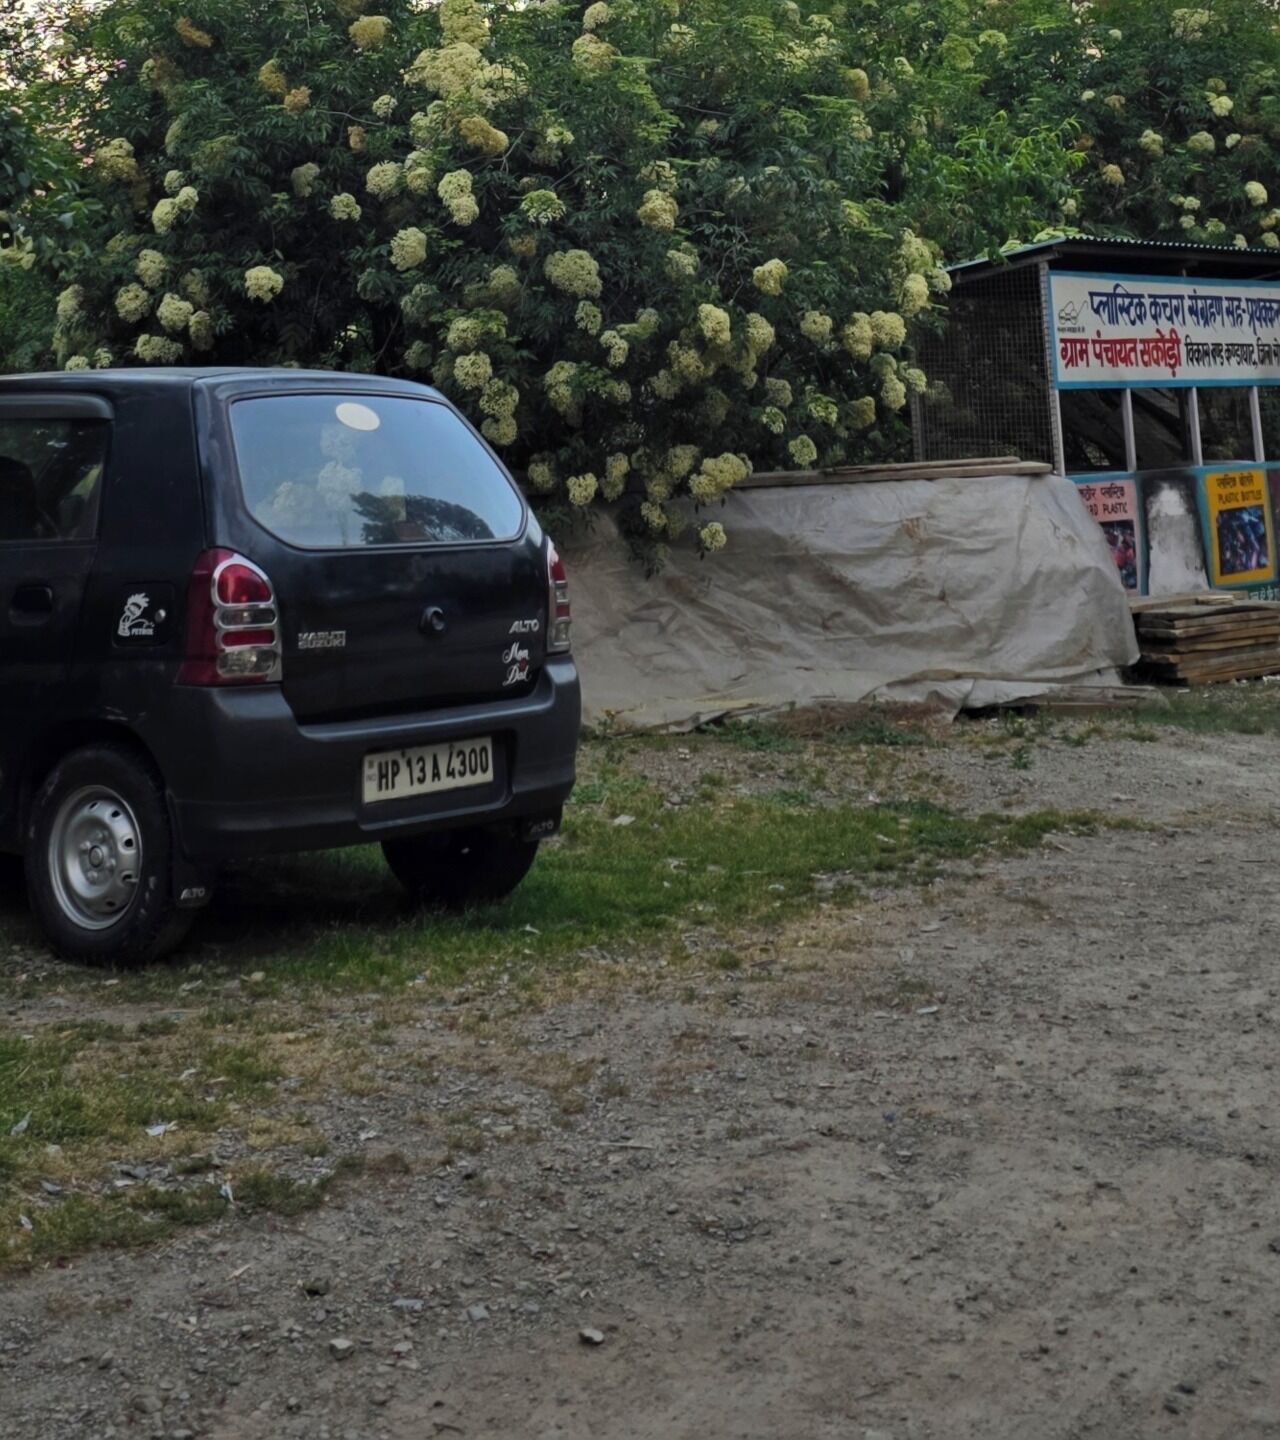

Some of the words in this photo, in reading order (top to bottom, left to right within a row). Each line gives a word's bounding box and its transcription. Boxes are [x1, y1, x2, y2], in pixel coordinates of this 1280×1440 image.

[1088, 283, 1145, 326] प्लास्टिक
[1147, 293, 1186, 327] कचरा
[1060, 338, 1089, 369] ग्राम
[1091, 329, 1138, 368] पंचायत
[1102, 501, 1129, 515] PLASTIC
[508, 618, 540, 635] ALTO
[298, 639, 346, 649] SUZUKI
[377, 758, 401, 792] HP
[406, 755, 427, 787] 13
[431, 752, 442, 783] A
[445, 745, 490, 780] 4300
